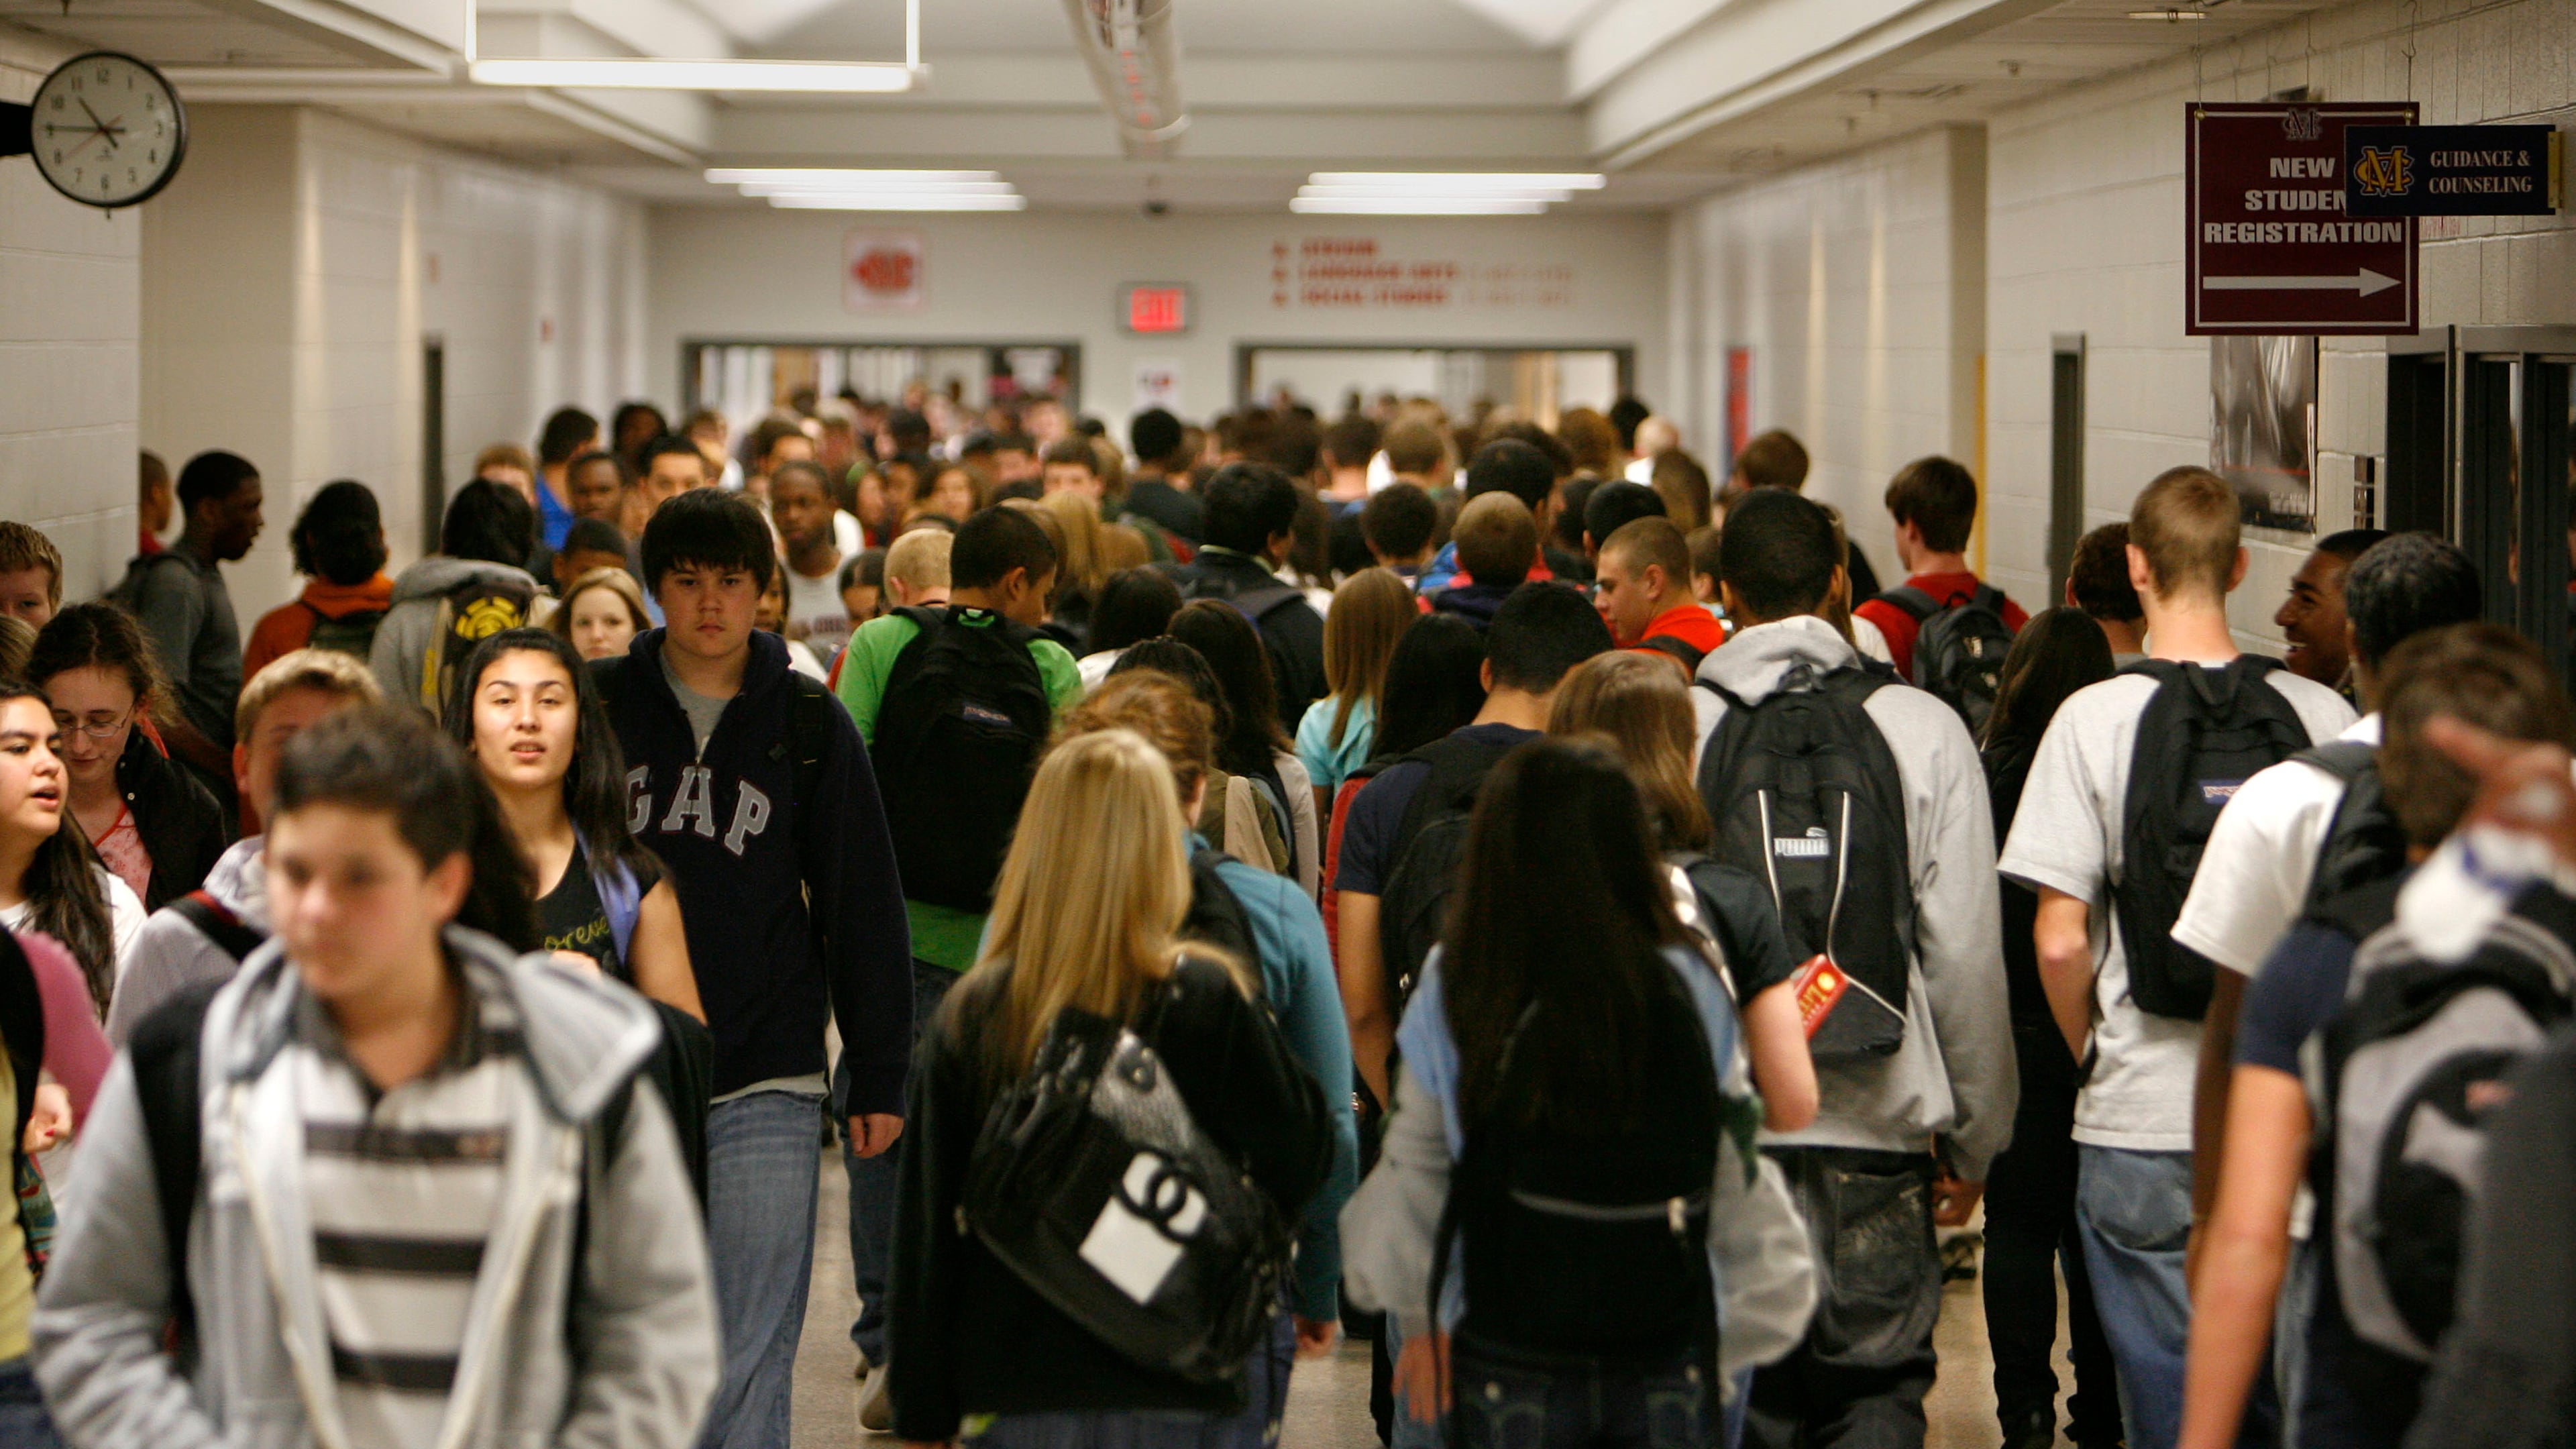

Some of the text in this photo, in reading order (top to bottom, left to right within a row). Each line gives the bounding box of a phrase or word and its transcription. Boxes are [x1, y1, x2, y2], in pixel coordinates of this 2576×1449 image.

[2270, 157, 2335, 178] NEW
[2430, 150, 2532, 168] GUIDANCE &
[2428, 176, 2533, 194] COUNSELING
[2245, 190, 2347, 211] STUDEN
[2204, 222, 2402, 244] REGISTRATION
[626, 765, 771, 856] GAP
